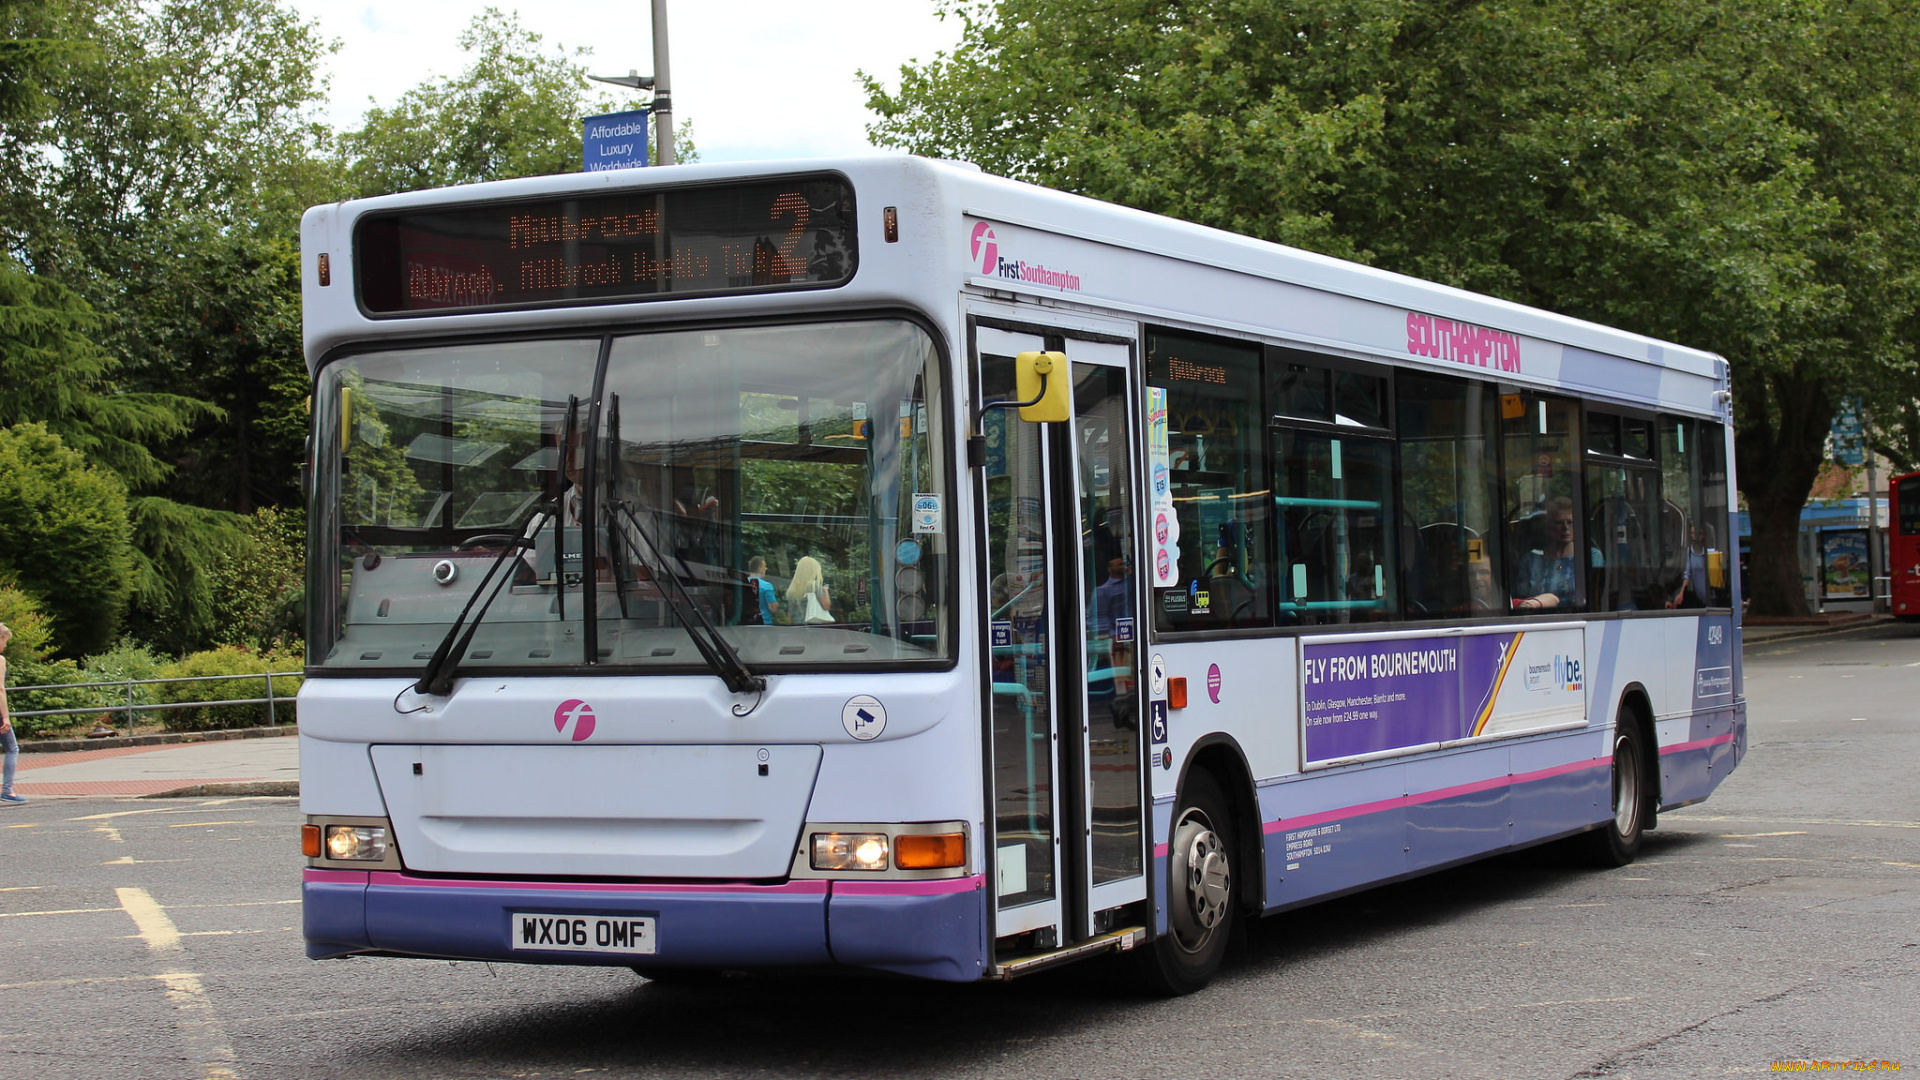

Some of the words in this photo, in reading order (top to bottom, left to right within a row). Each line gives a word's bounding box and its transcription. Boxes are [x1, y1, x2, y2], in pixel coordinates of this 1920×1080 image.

[590, 122, 641, 139] Affordable
[600, 143, 634, 157] Luxury
[589, 158, 642, 172] Worldwide
[510, 208, 660, 249] Millbrook
[521, 253, 621, 290] Millbrook
[1406, 311, 1521, 374] SOUTHAMPTON
[1168, 356, 1227, 384] Millbrook
[1305, 658, 1327, 685] FLY
[1330, 655, 1367, 682] FROM
[1371, 649, 1456, 679] BOURNEMOUTH
[1327, 699, 1346, 710] Glasgow,
[1346, 696, 1373, 708] Manchester,
[1313, 715, 1322, 726] sale
[1323, 715, 1332, 724] now
[1332, 713, 1343, 723] from
[1359, 712, 1369, 720] one
[522, 917, 588, 947] WX06
[595, 920, 645, 948] OMF
